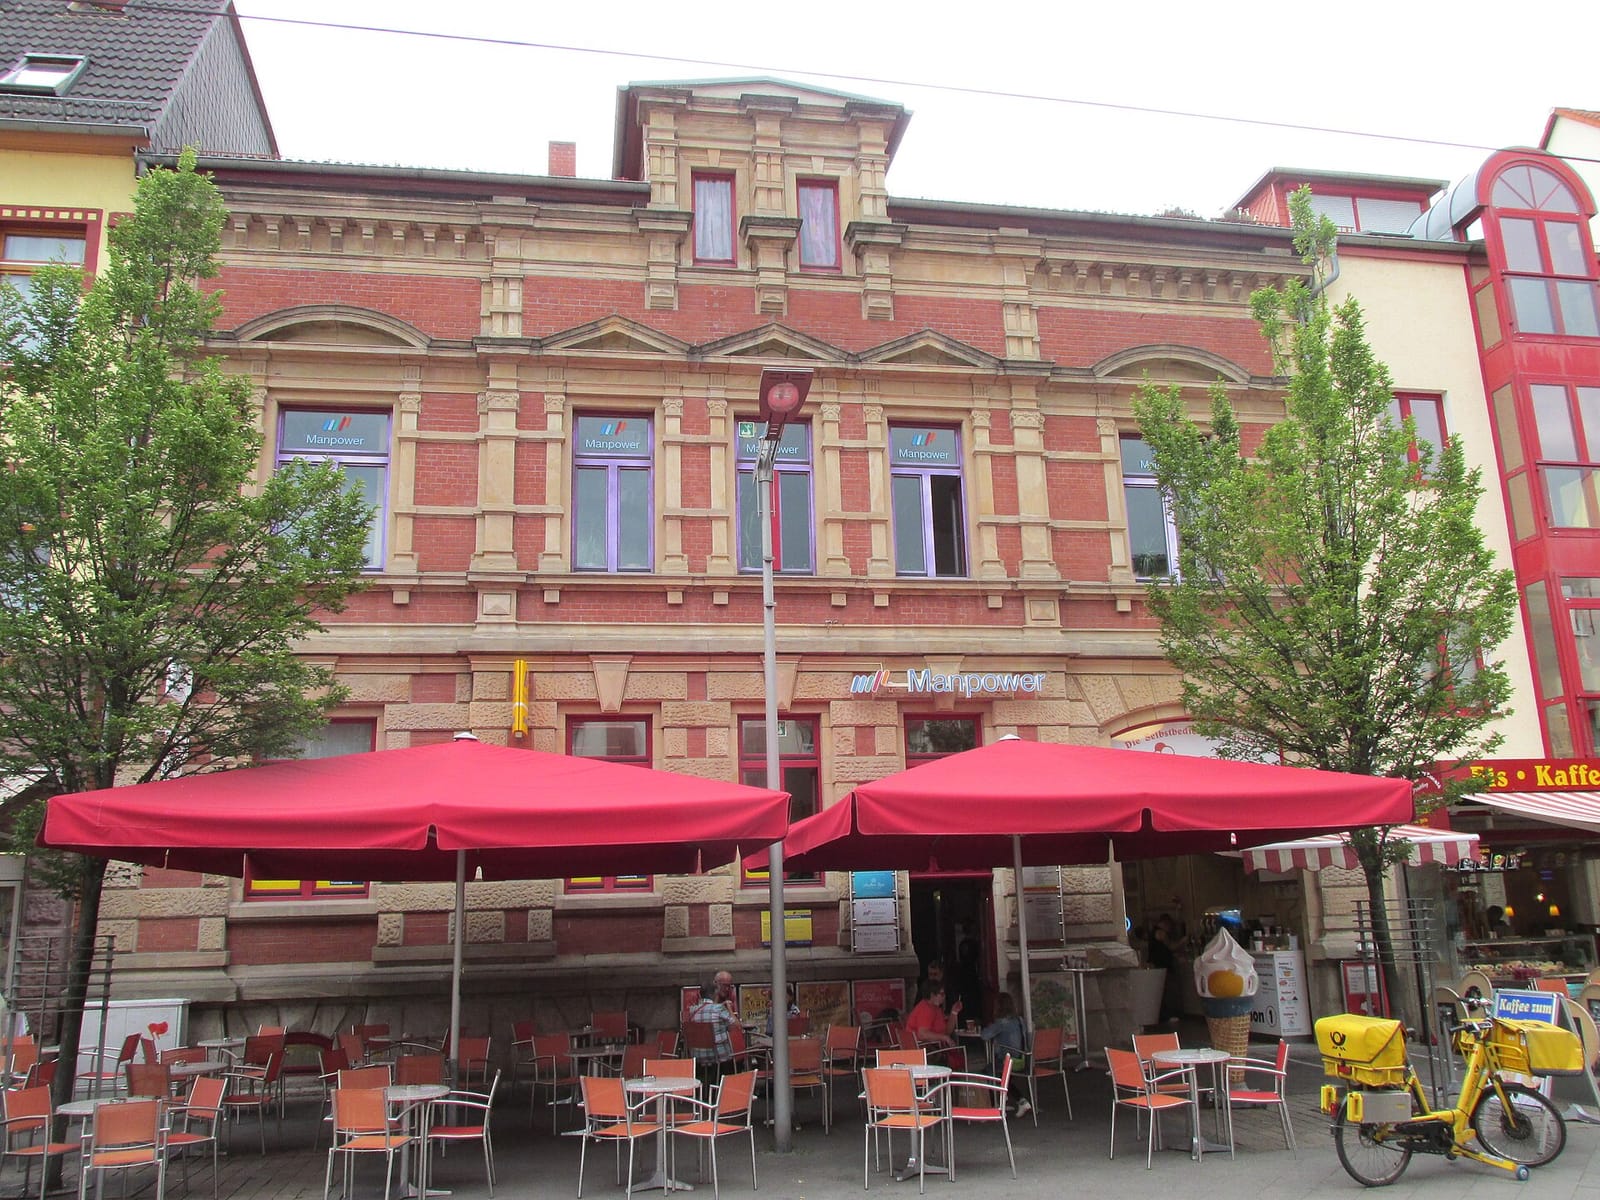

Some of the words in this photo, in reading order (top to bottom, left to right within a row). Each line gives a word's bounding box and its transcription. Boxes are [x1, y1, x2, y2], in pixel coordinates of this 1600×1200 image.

[306, 434, 365, 446] Manpower
[585, 439, 640, 451] Manpower
[898, 448, 949, 461] Manpower
[907, 668, 1045, 698] Manpower
[1124, 738, 1141, 749] Die
[1499, 998, 1530, 1014] Kaffee
[1531, 1003, 1552, 1014] zum
